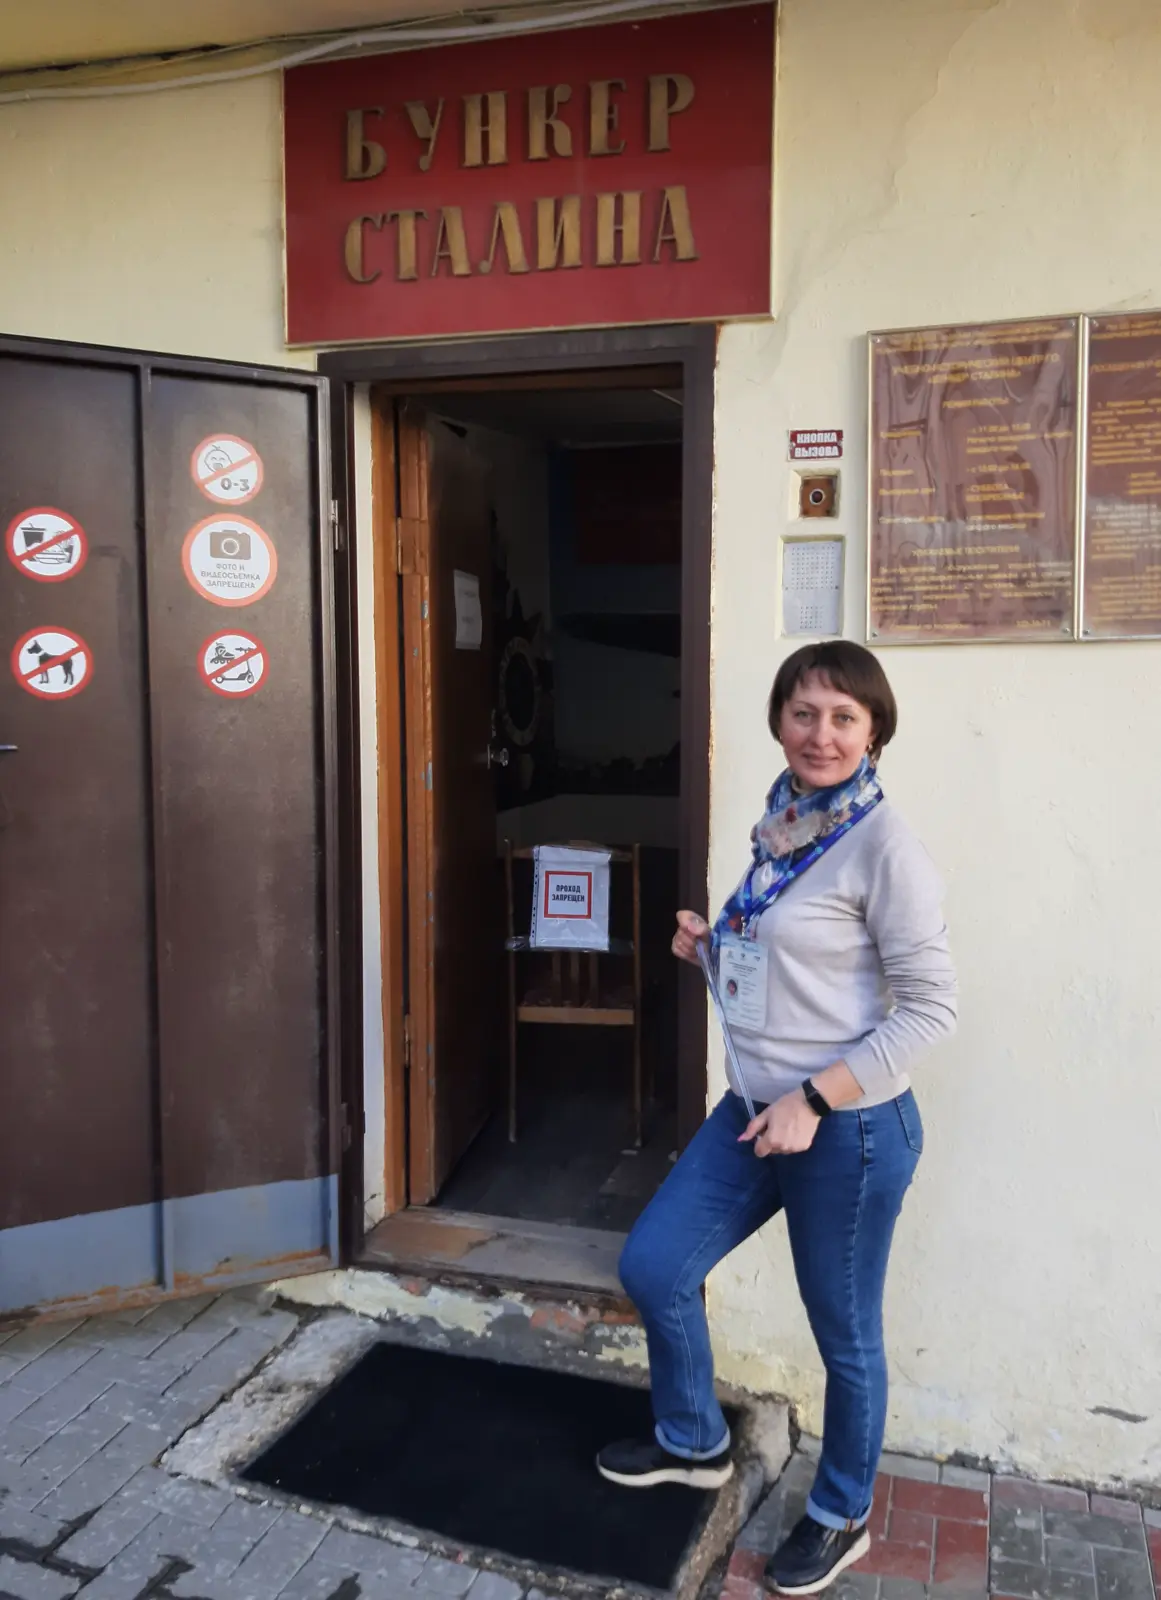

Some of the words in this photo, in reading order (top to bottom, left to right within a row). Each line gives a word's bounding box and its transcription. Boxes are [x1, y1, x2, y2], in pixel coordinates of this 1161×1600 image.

[344, 73, 695, 180] БУНКЕР
[344, 185, 699, 284] СТАЛИНА
[796, 432, 838, 444] КНОПКА
[794, 445, 839, 458] ВЫЗОВА
[220, 477, 250, 491] 0-3
[216, 563, 238, 571] ФОТО
[200, 571, 261, 581] ВИДЕОСЪЕМКА
[206, 580, 256, 589] ЗАПРЕЩЕНА
[555, 884, 581, 893] ПРОХОД
[551, 893, 585, 903] ЗАПРЕЩЕН
